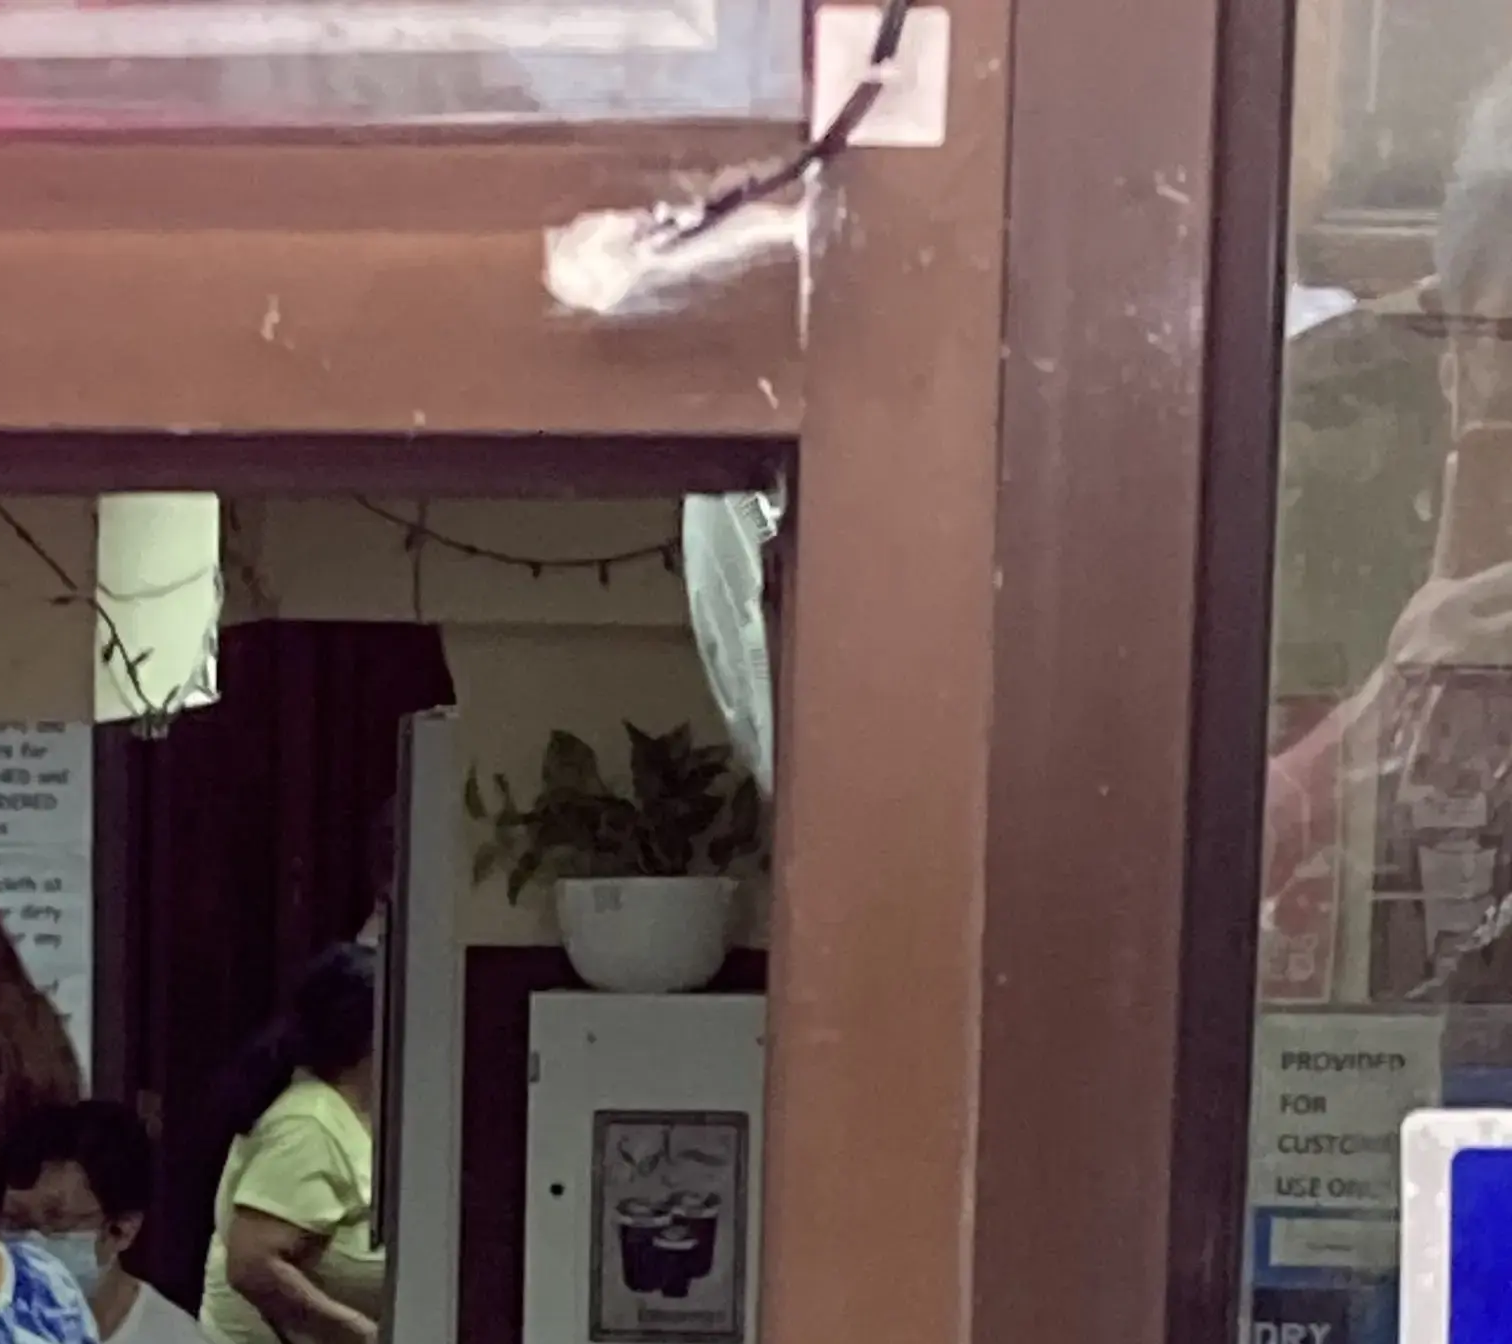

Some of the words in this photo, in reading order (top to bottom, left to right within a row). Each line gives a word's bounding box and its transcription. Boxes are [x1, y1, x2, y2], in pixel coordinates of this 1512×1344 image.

[1280, 1051, 1406, 1071] PROVIDED
[1279, 1094, 1327, 1115] FOR
[1276, 1176, 1320, 1198] USE
